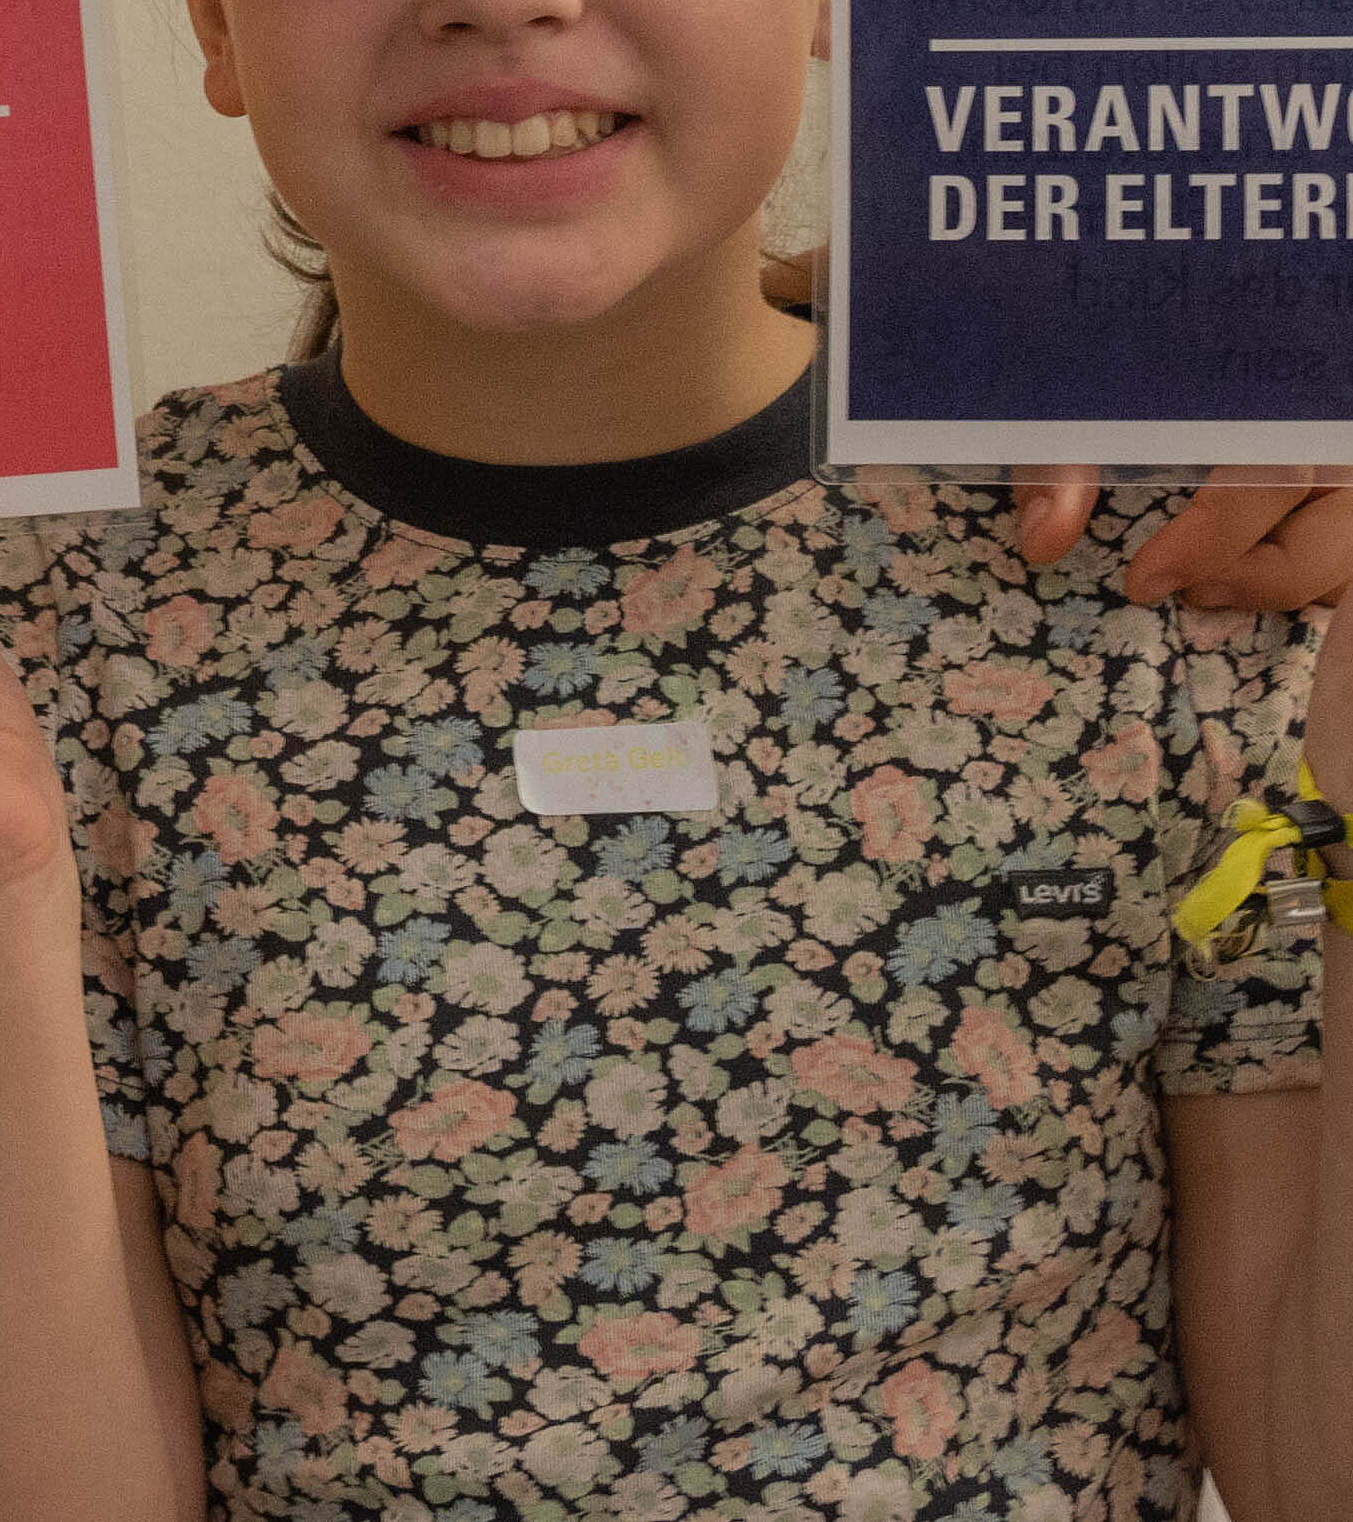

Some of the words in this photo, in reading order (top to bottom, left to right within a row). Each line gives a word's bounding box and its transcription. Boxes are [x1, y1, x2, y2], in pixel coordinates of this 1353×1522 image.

[925, 83, 1353, 152] VERANTW
[929, 174, 1080, 240] DER
[1105, 173, 1353, 240] ELTER
